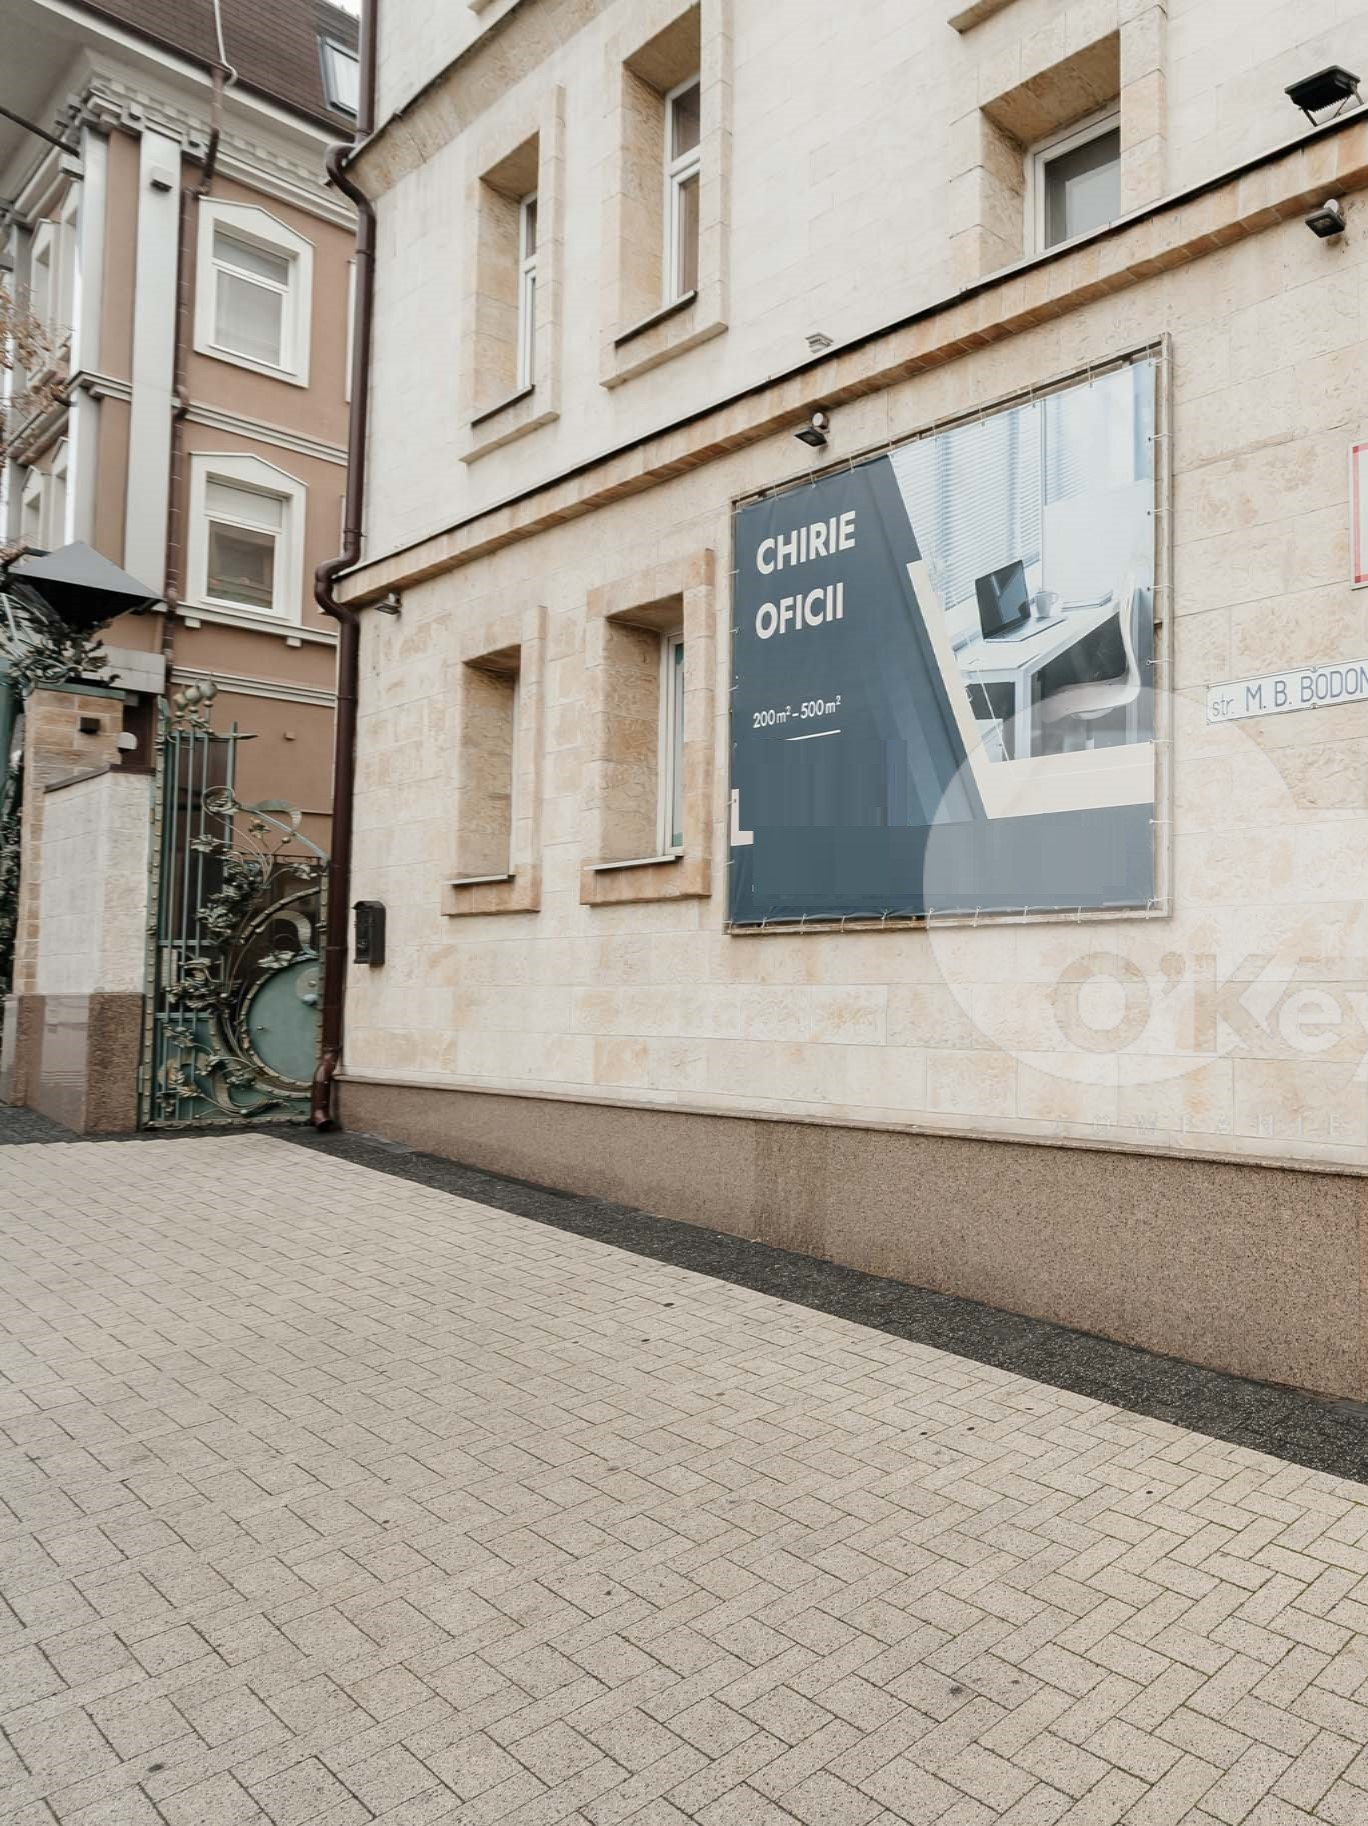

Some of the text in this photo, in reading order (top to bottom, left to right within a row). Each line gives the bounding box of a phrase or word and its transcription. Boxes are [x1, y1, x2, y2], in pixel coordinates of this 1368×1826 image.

[756, 510, 856, 575] CHIRIE
[755, 582, 844, 640] OFICII
[1212, 694, 1235, 717] str.
[1246, 684, 1267, 712] M.
[1274, 680, 1292, 707] B.
